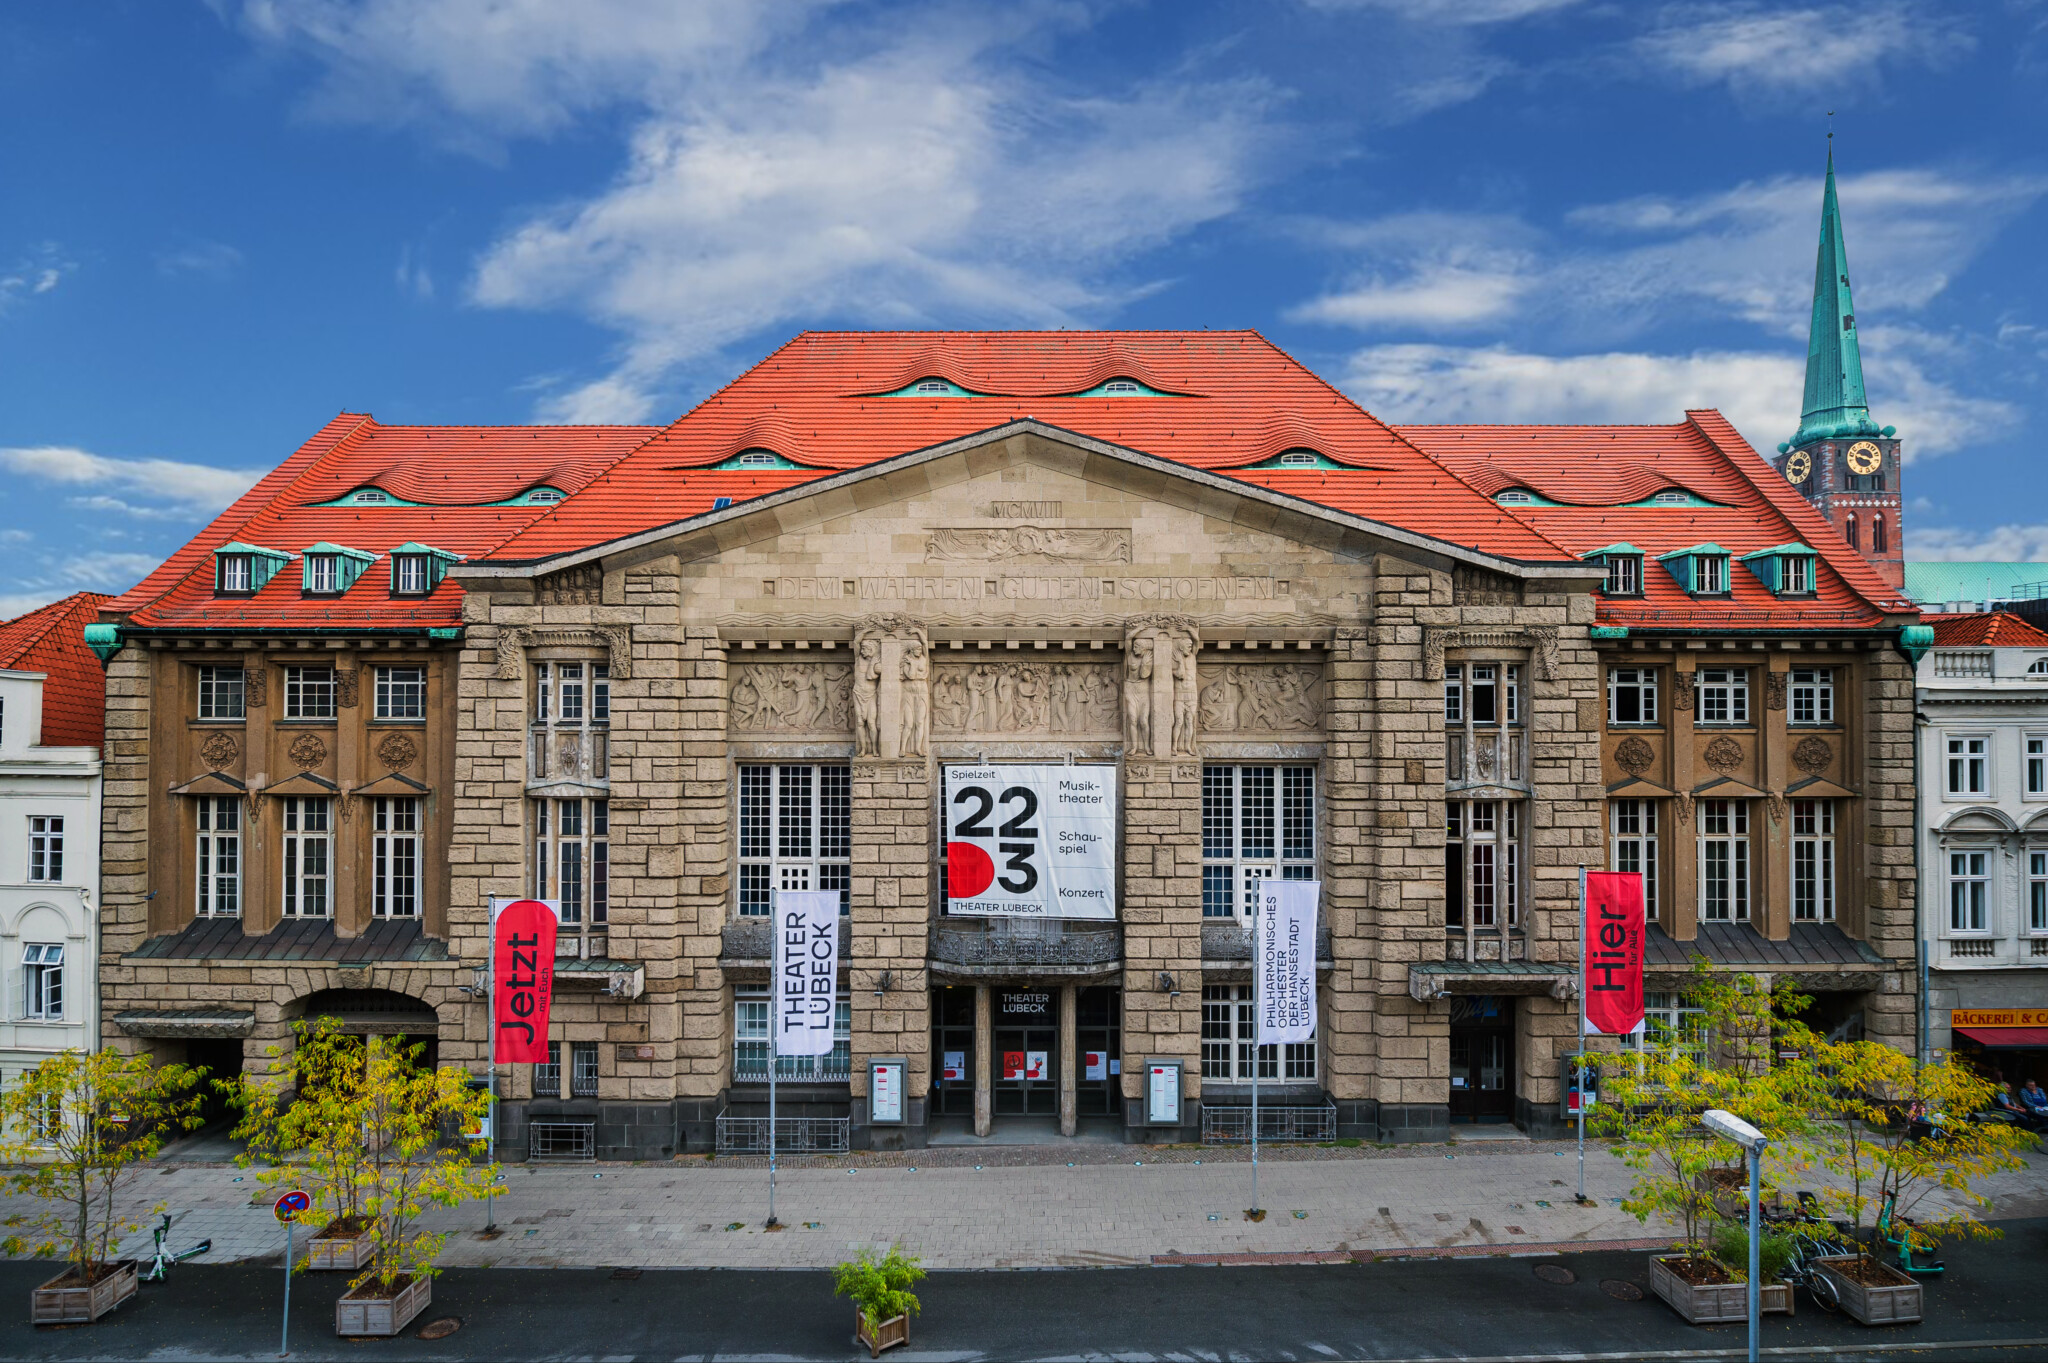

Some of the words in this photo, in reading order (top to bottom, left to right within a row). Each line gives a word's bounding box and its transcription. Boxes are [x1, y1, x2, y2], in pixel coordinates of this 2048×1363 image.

[993, 501, 1061, 518] MCMVIII
[781, 577, 839, 599] DEM
[860, 577, 981, 599] WAHREN
[1002, 577, 1099, 600] GUTEN
[1120, 577, 1275, 600] SCHOENEN
[951, 770, 996, 780] Spielzeit
[1059, 780, 1100, 791] Musik-
[1059, 794, 1104, 804] theater
[953, 785, 1039, 838] 22
[1059, 831, 1103, 842] Schau-
[1059, 844, 1087, 856] spiel
[997, 842, 1039, 894] 3
[1059, 887, 1104, 899] Konzert
[954, 902, 999, 912] THEATER
[1002, 903, 1043, 913] LÜBECK
[1592, 903, 1626, 991] Hier
[1629, 929, 1638, 950] Alle
[1266, 896, 1277, 1028] PHILHARMONISCHES
[1289, 917, 1300, 1002] HANSESTADT
[538, 967, 549, 993] Euch
[784, 911, 806, 1033] THEATER
[809, 922, 832, 1030] LÜBECK
[500, 932, 538, 1046] Jetzt
[1002, 993, 1049, 1003] THEATER
[1277, 950, 1287, 1029] ORCHESTER
[538, 996, 547, 1012] mit
[1003, 1003, 1045, 1013] LÜBECK
[1300, 976, 1310, 1027] LÜBECK
[1289, 1002, 1299, 1027] DER
[1953, 1011, 2014, 1025] BÄCKEREI
[2021, 1013, 2032, 1024] &
[2036, 1013, 2048, 1024] C
